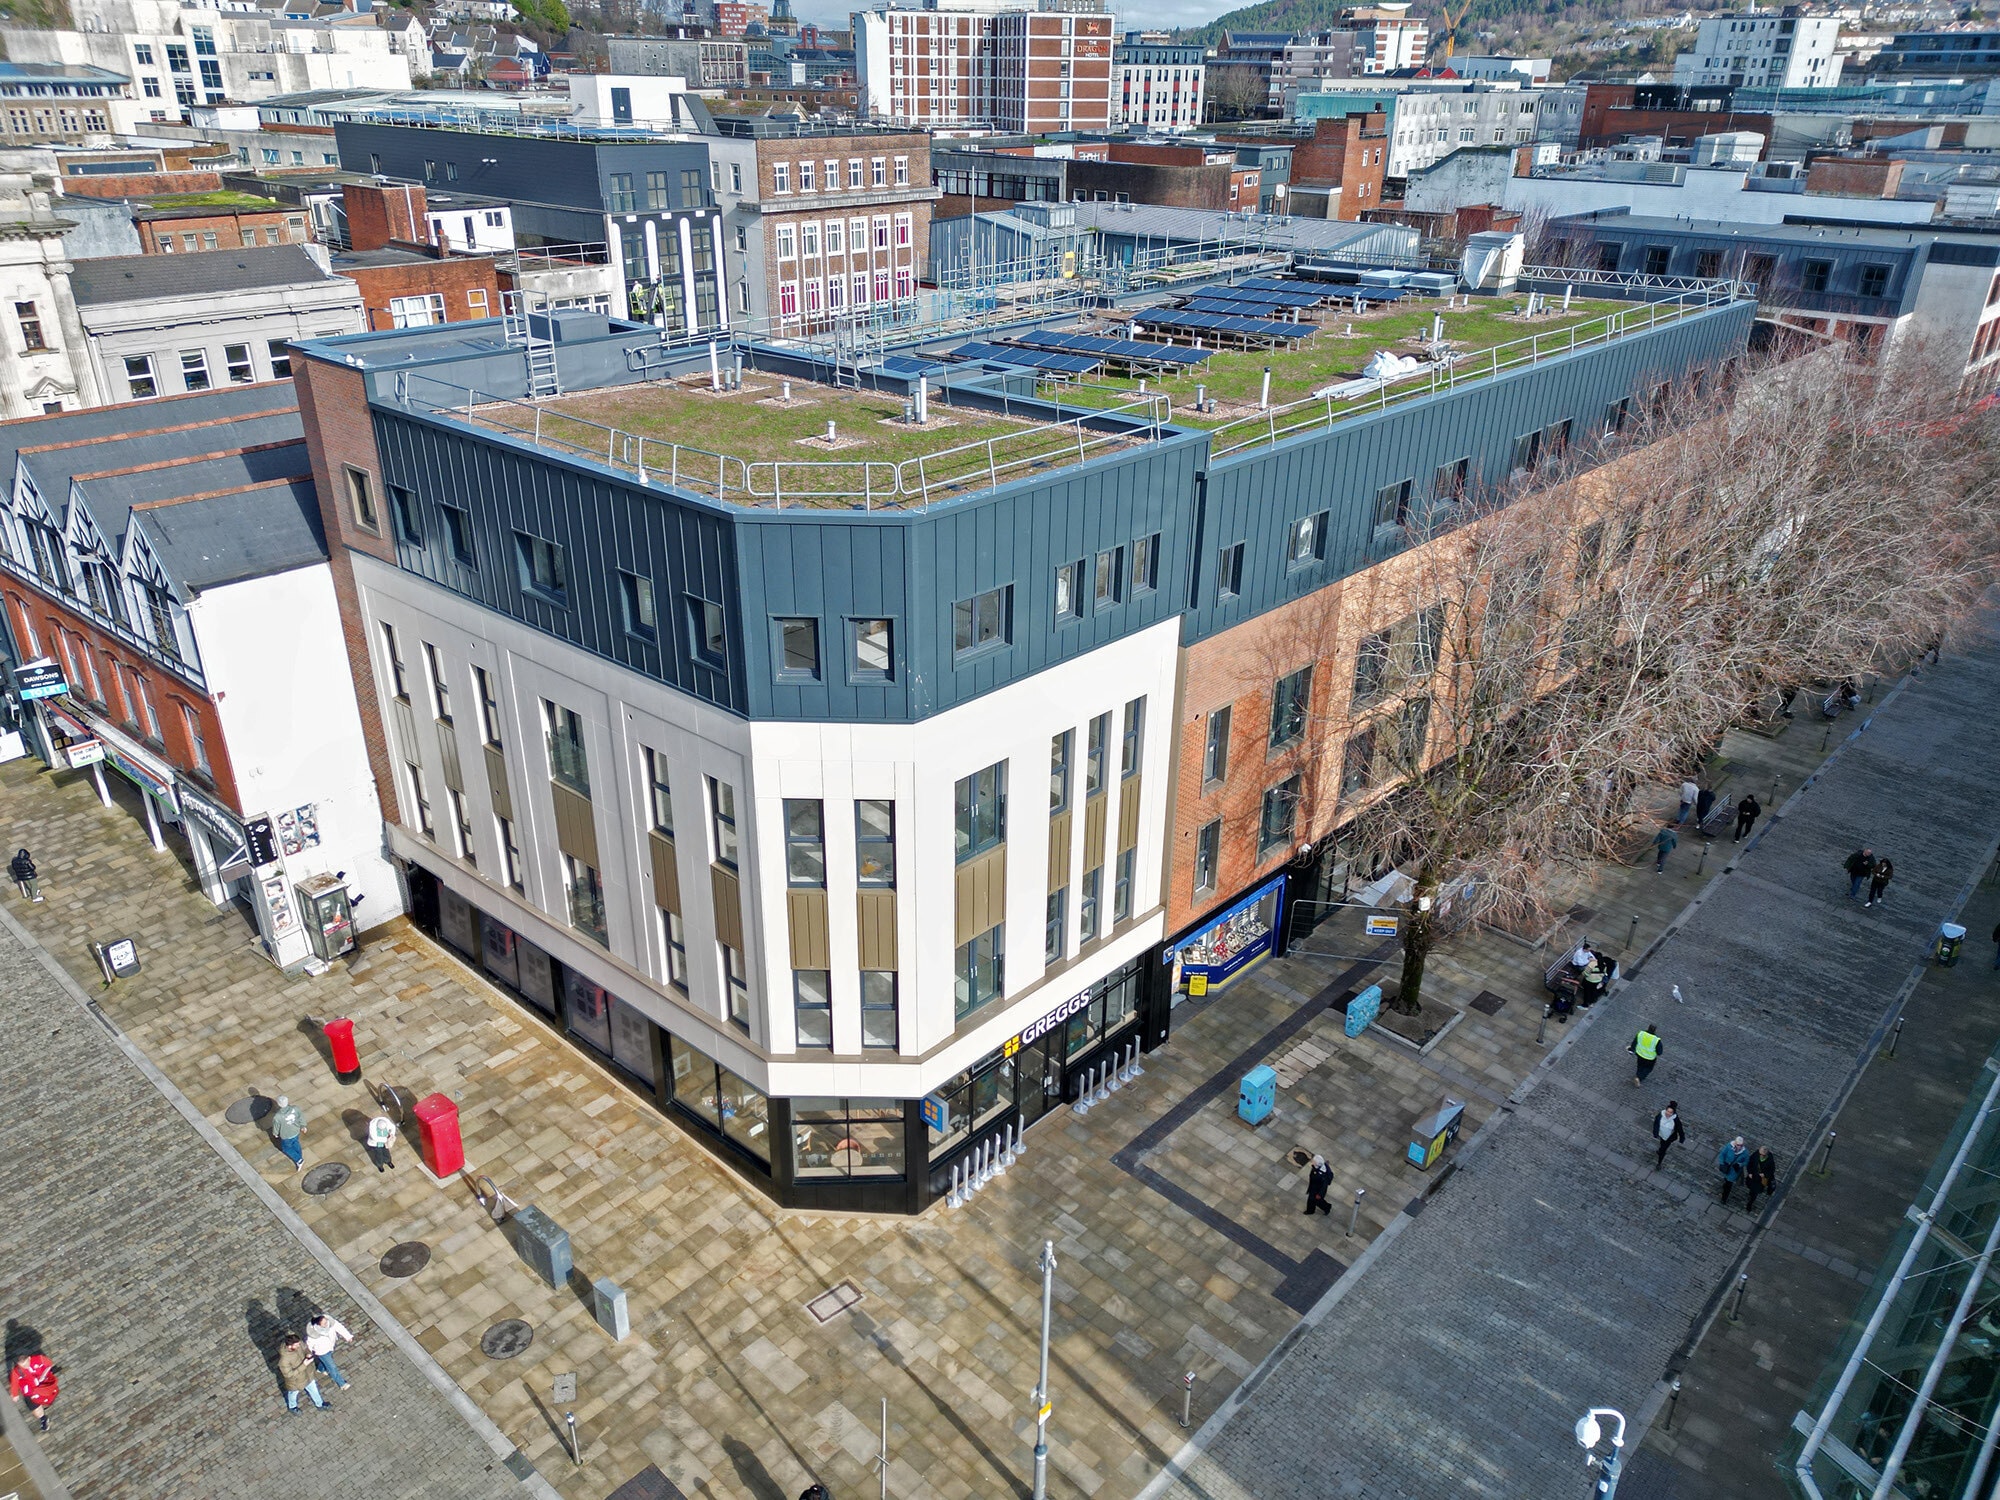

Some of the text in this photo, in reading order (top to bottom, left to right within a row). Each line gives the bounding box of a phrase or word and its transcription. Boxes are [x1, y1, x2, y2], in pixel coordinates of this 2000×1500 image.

[1077, 45, 1108, 53] DRAGON
[23, 672, 59, 683] DAWSONS
[30, 688, 43, 697] TO
[45, 684, 61, 695] LET
[1022, 989, 1089, 1044] GREGGS
